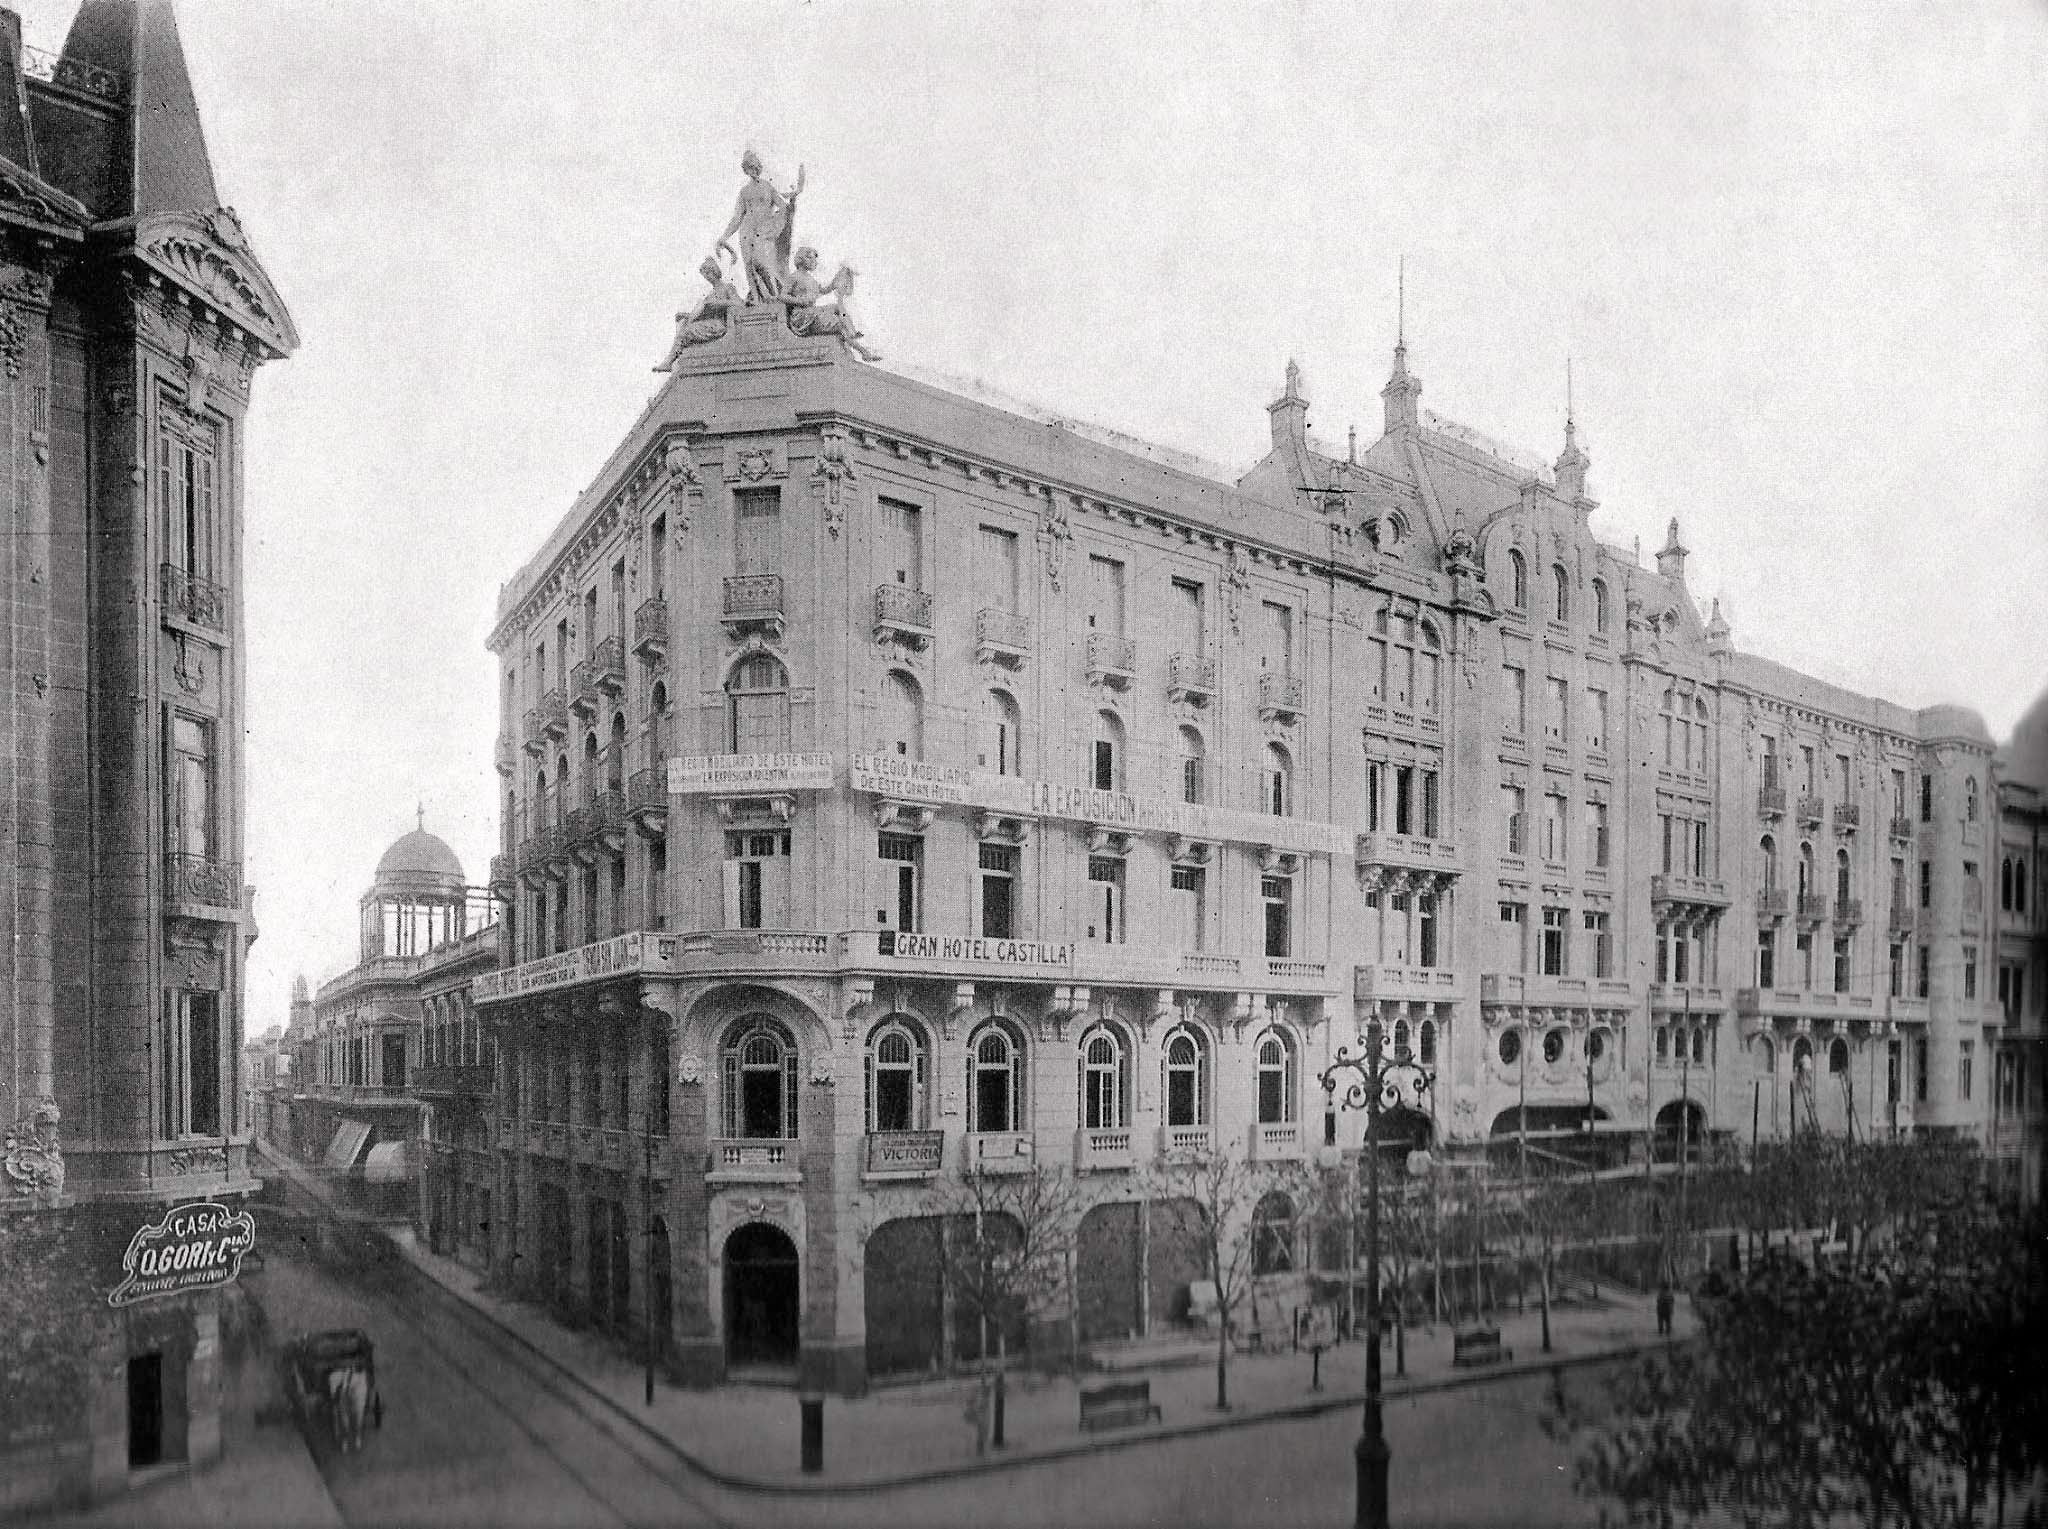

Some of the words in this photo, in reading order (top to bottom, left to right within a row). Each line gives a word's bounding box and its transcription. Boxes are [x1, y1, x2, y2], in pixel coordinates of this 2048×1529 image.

[774, 753, 798, 767] ESTE
[801, 753, 831, 766] HOTEL
[854, 754, 869, 772] EL
[873, 757, 908, 777] REGIO
[911, 763, 971, 786] MOBILIARIO
[861, 775, 875, 789] DE
[878, 776, 902, 794] ESTE
[905, 781, 929, 797] GRAN
[932, 784, 963, 802] HOTEL
[1031, 782, 1049, 813] LA
[1056, 785, 1136, 824] EXPOSICION
[898, 934, 937, 957] GRAN
[943, 936, 990, 961] HOTEL
[997, 941, 1067, 965] CASTILLA
[882, 1147, 941, 1161] VICTORIA
[175, 1212, 217, 1237] CASA
